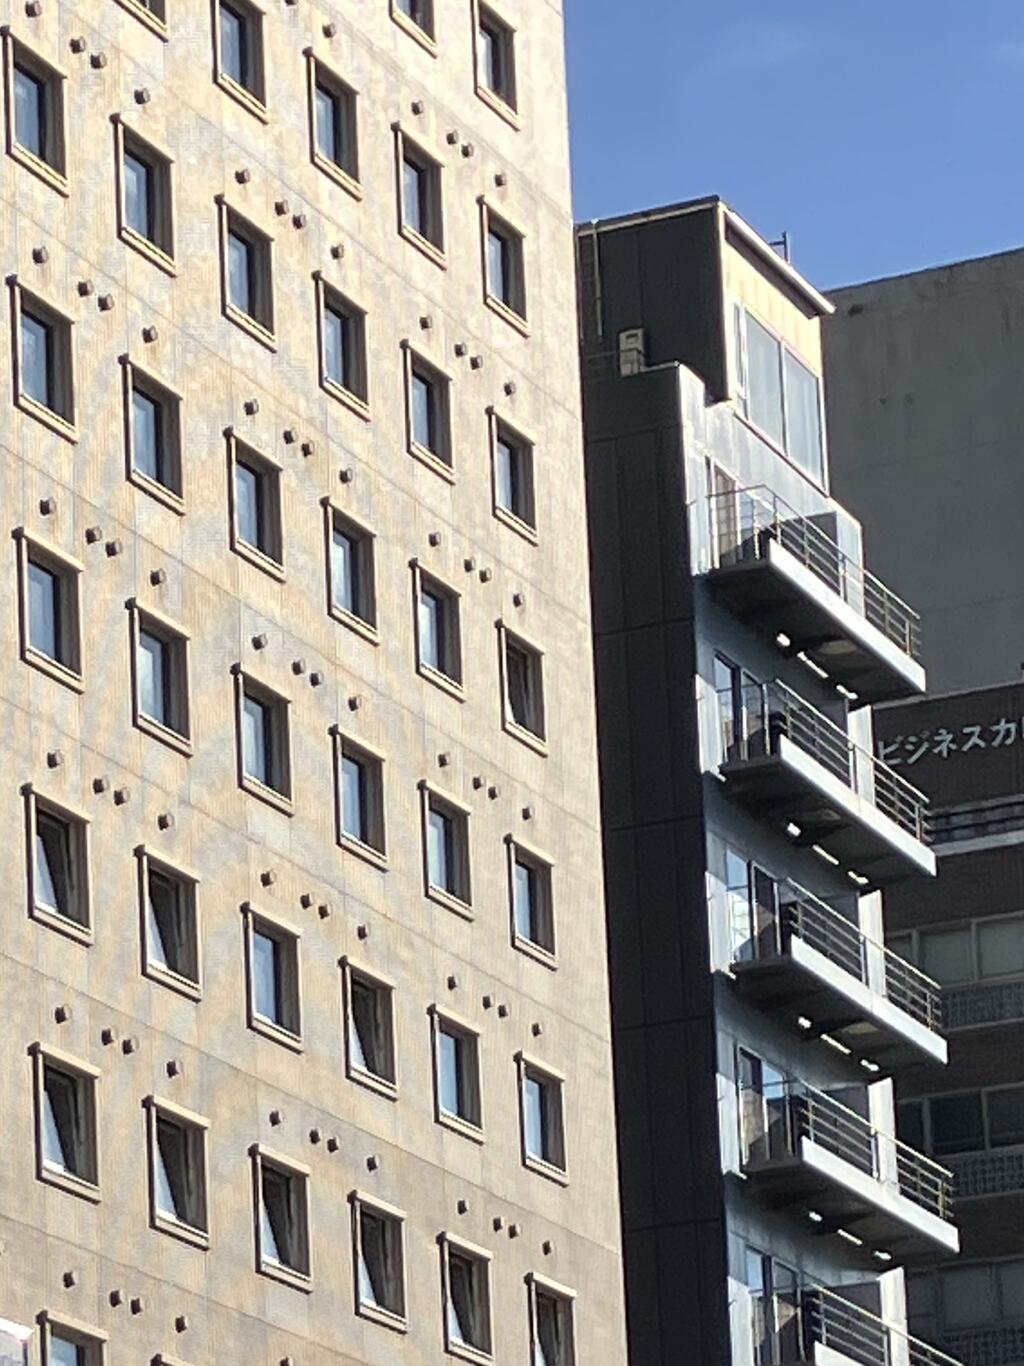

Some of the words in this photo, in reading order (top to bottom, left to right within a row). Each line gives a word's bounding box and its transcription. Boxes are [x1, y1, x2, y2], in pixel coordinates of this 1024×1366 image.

[878, 716, 1024, 765] ビジネスカ
